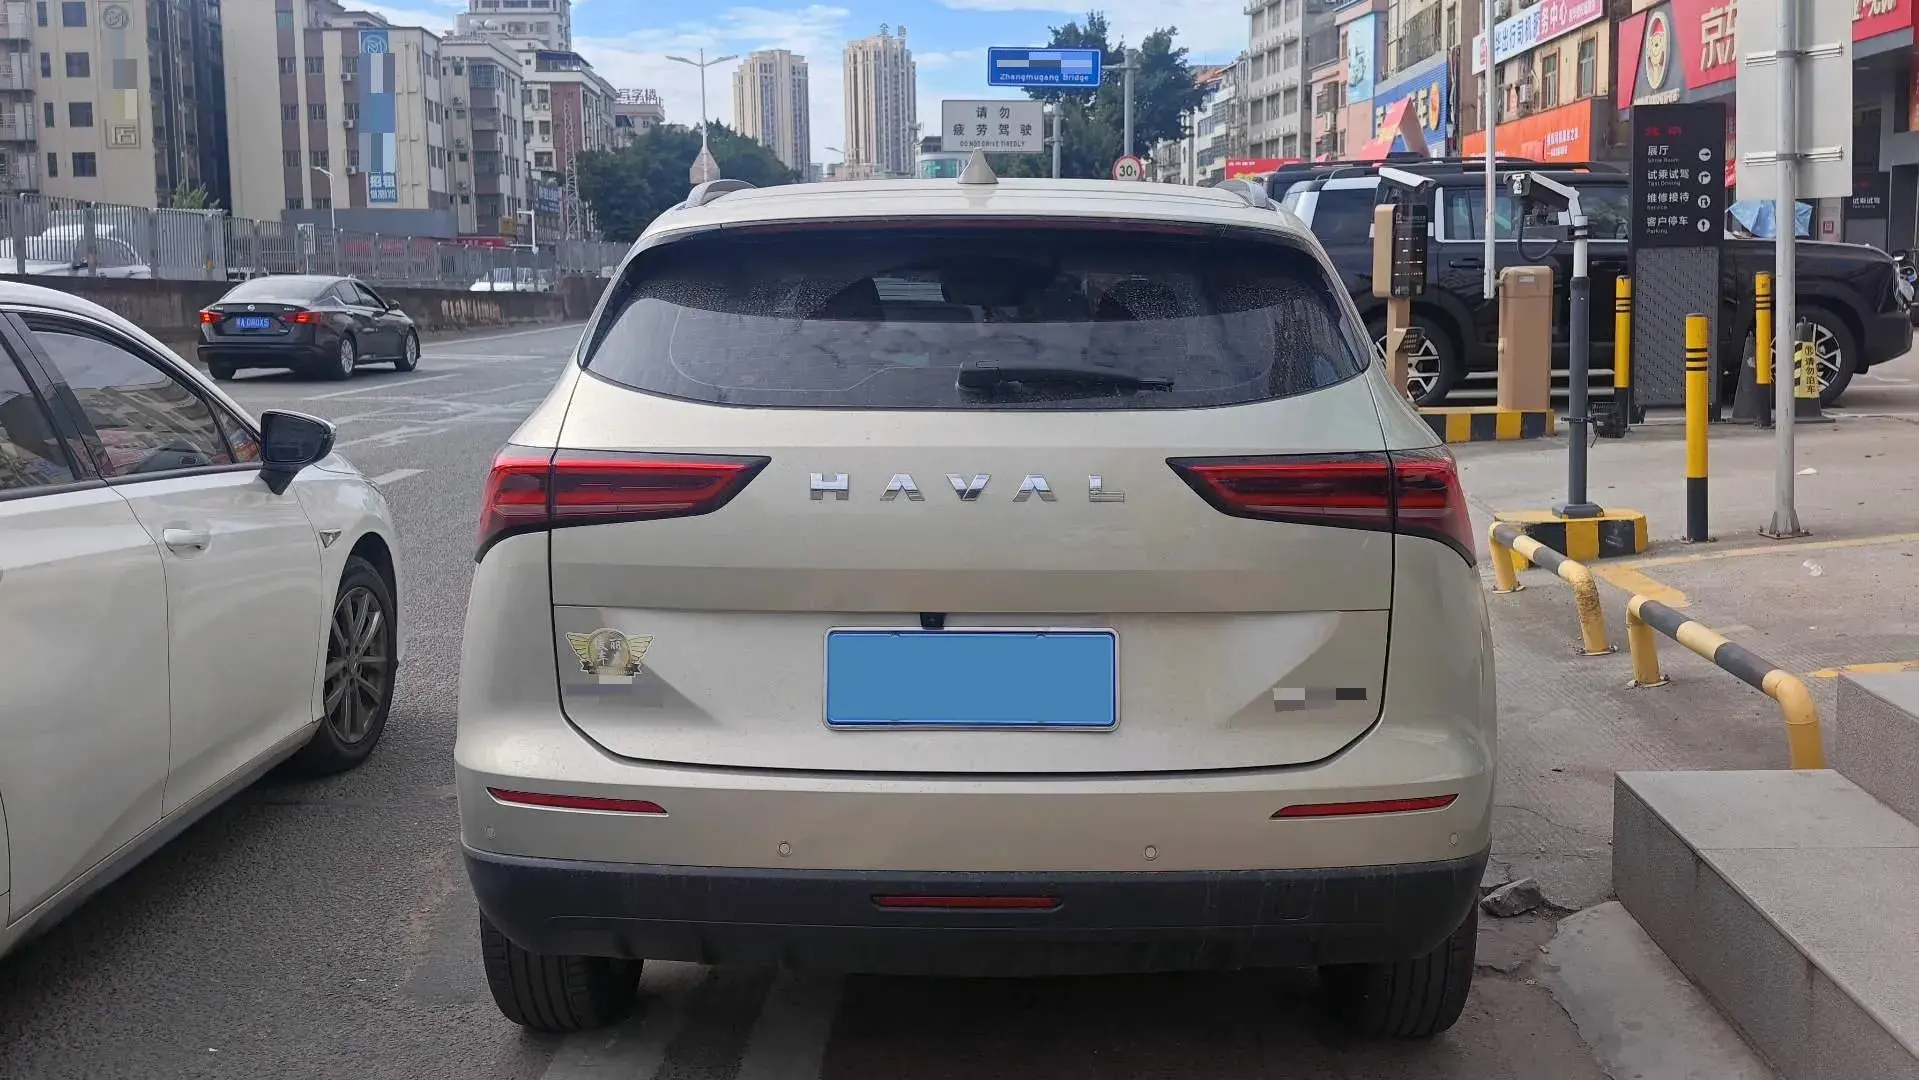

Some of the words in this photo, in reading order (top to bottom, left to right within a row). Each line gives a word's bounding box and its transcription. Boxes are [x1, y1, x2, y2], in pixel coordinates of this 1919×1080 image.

[1063, 73, 1089, 82] Bridge
[976, 106, 1010, 119] 请勿
[953, 123, 1032, 136] 疲劳驾驶
[1648, 145, 1669, 156] 展厅
[1647, 192, 1690, 203] 维修接待
[1647, 216, 1689, 227] 客户停车
[1805, 357, 1816, 394] 请勿泊车
[810, 473, 1126, 503] HAVAL
